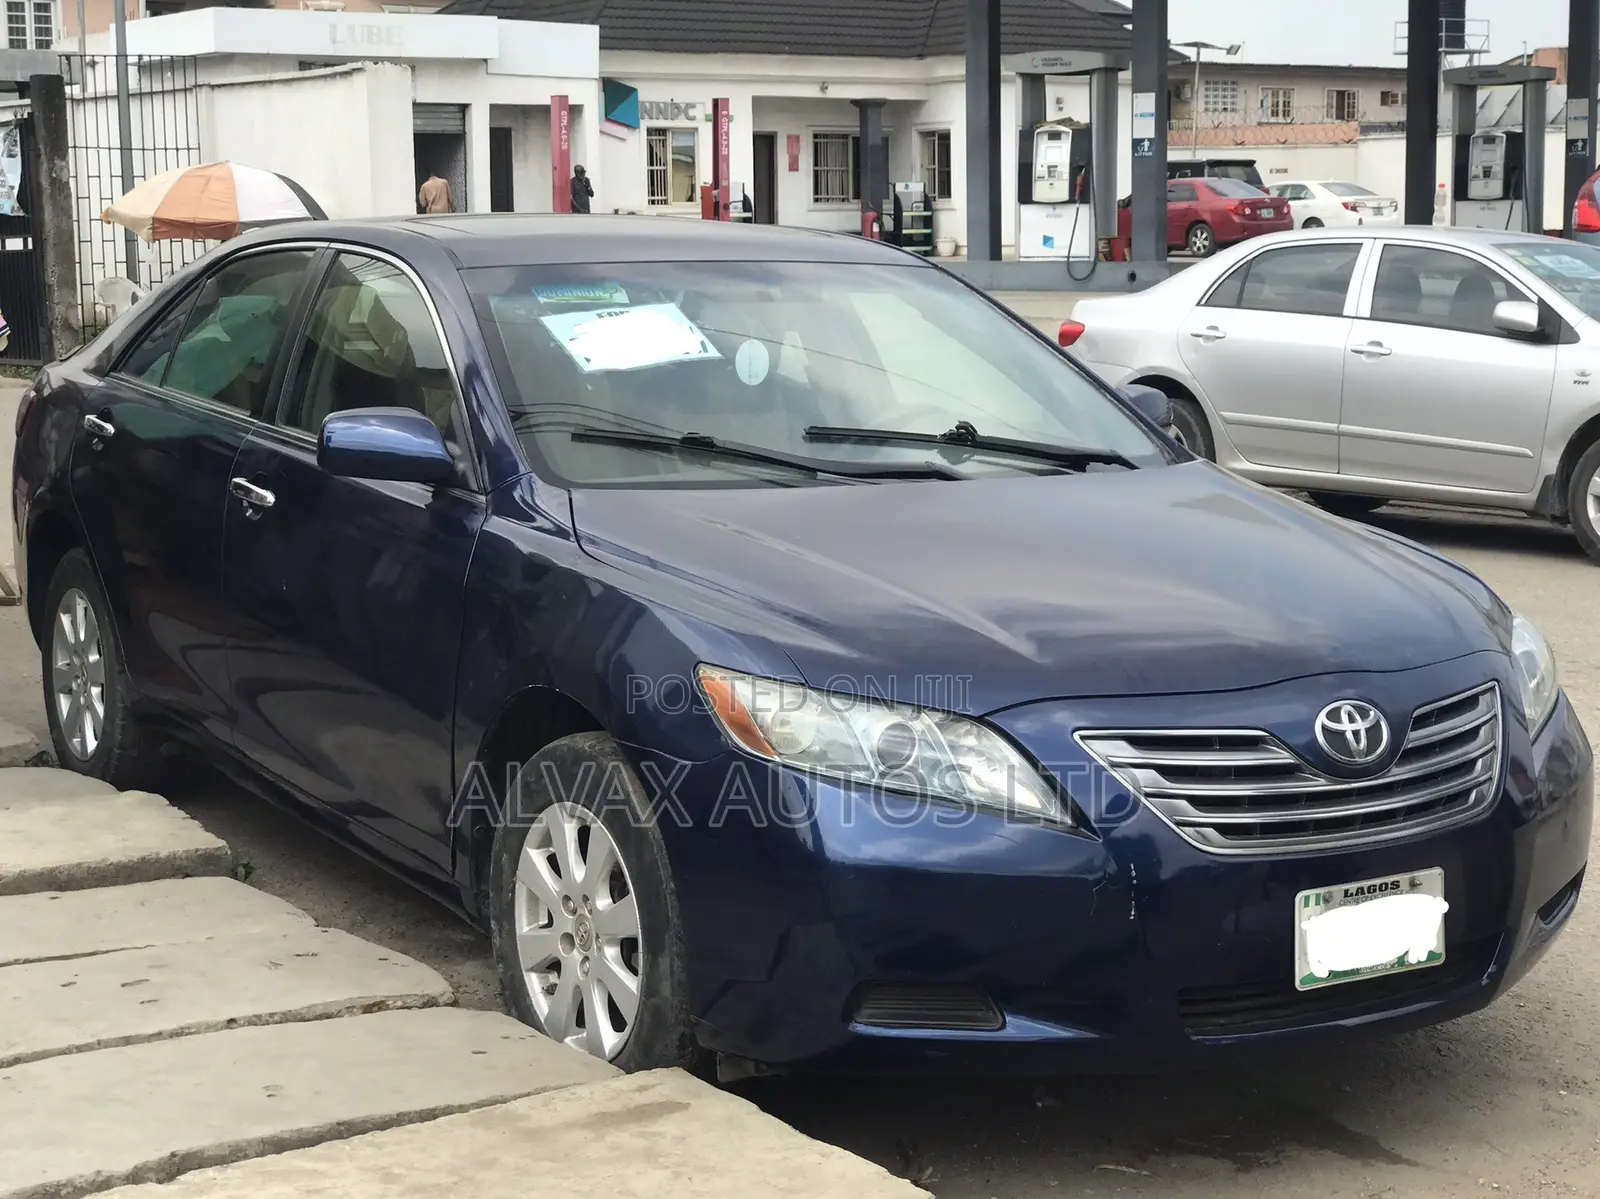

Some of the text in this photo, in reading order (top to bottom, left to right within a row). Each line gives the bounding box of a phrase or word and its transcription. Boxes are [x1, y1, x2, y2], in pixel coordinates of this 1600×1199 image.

[329, 22, 405, 46] LUBE
[640, 101, 697, 121] NNPC
[1343, 880, 1400, 899] LAGOS
